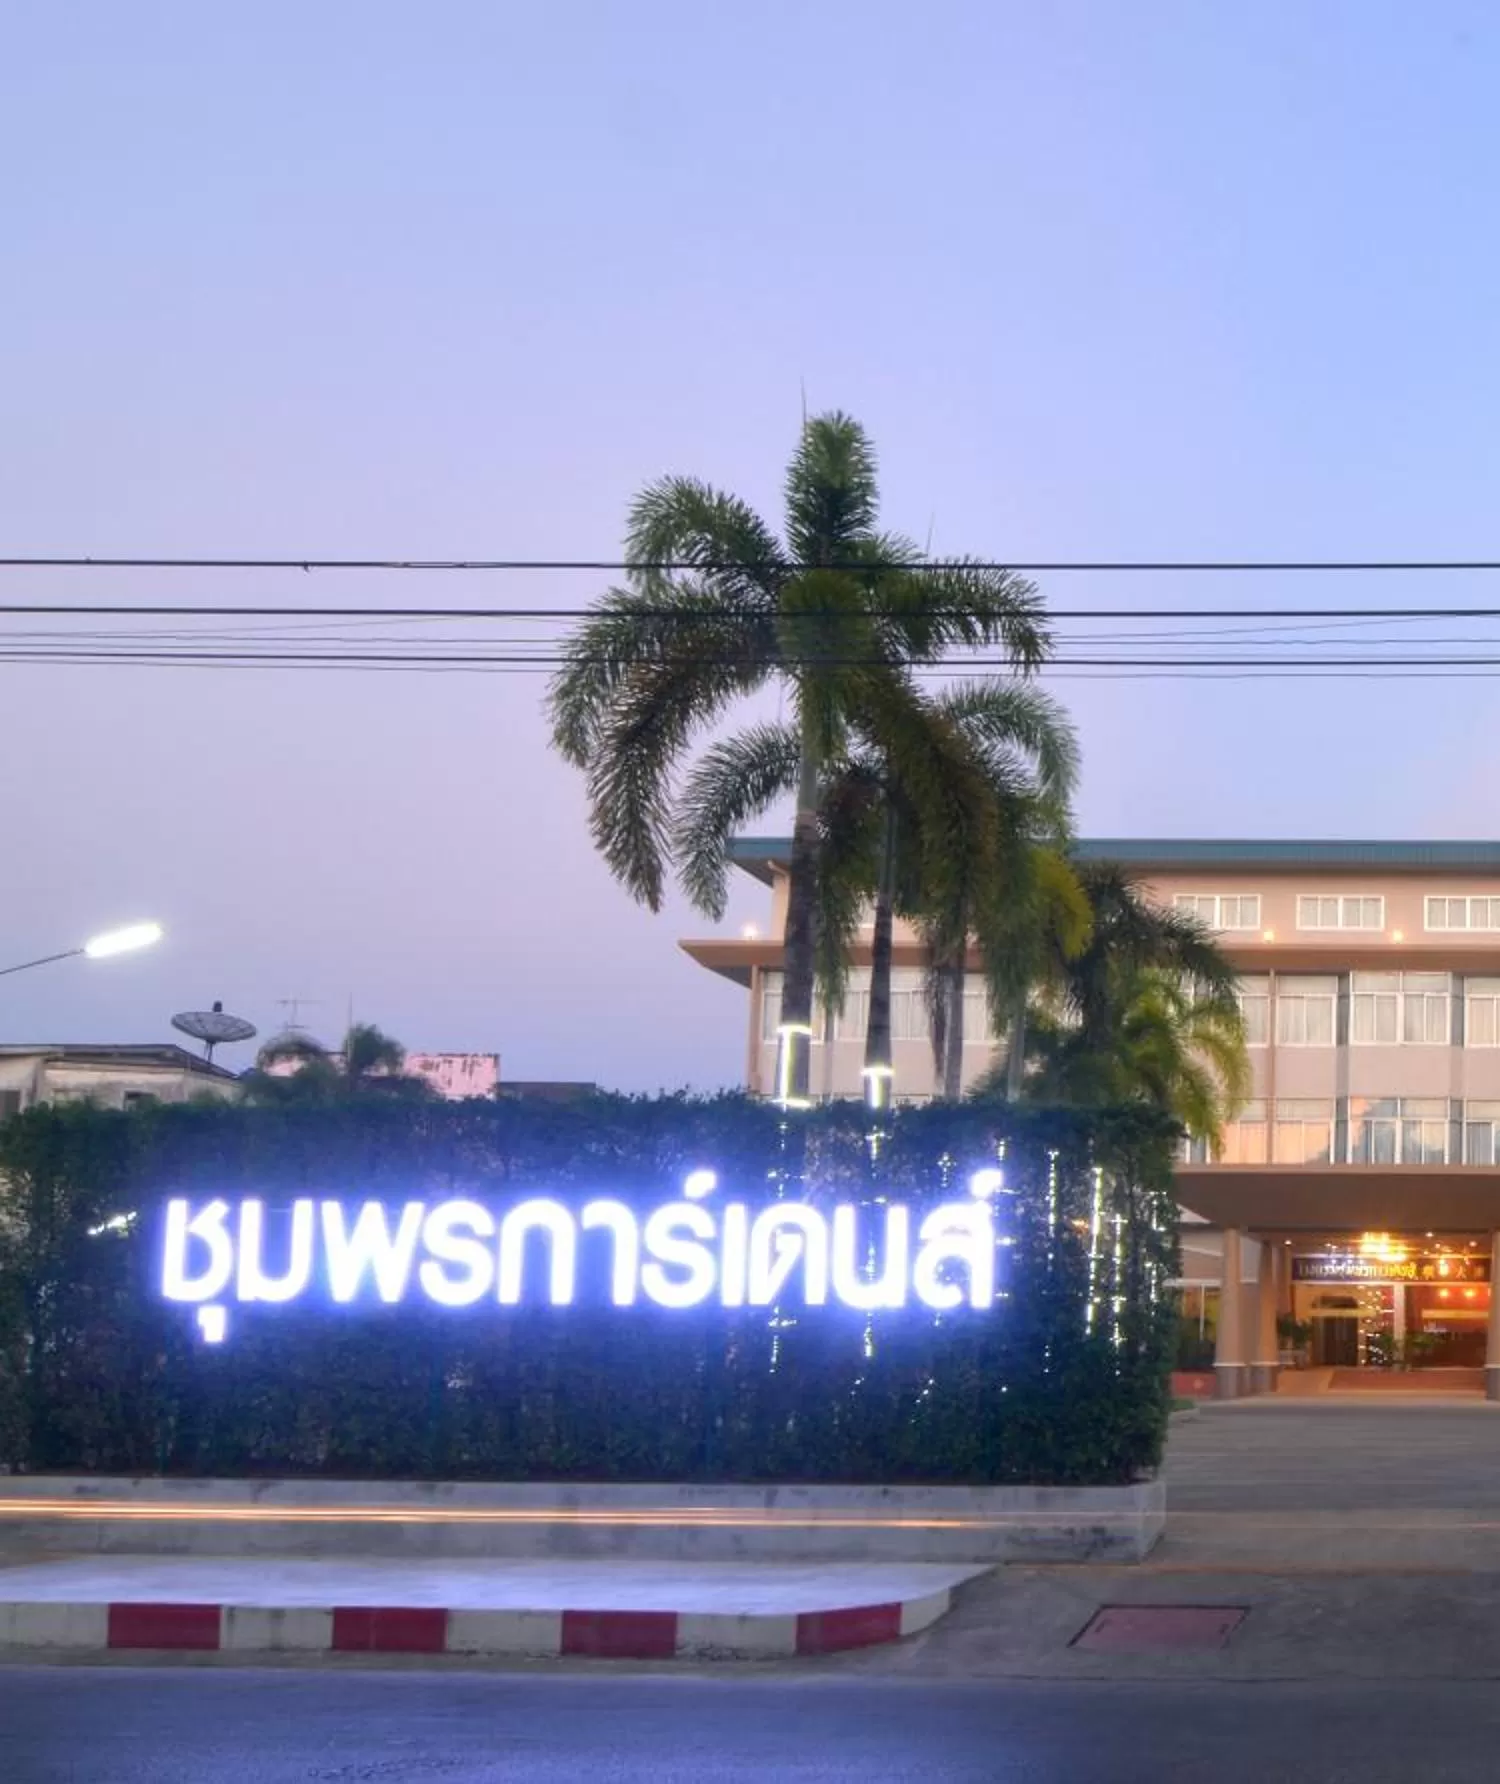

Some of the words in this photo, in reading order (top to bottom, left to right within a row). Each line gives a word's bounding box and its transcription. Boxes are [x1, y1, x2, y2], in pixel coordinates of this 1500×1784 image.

[160, 1167, 1002, 1343] ชุมพรการ์เดนส์
